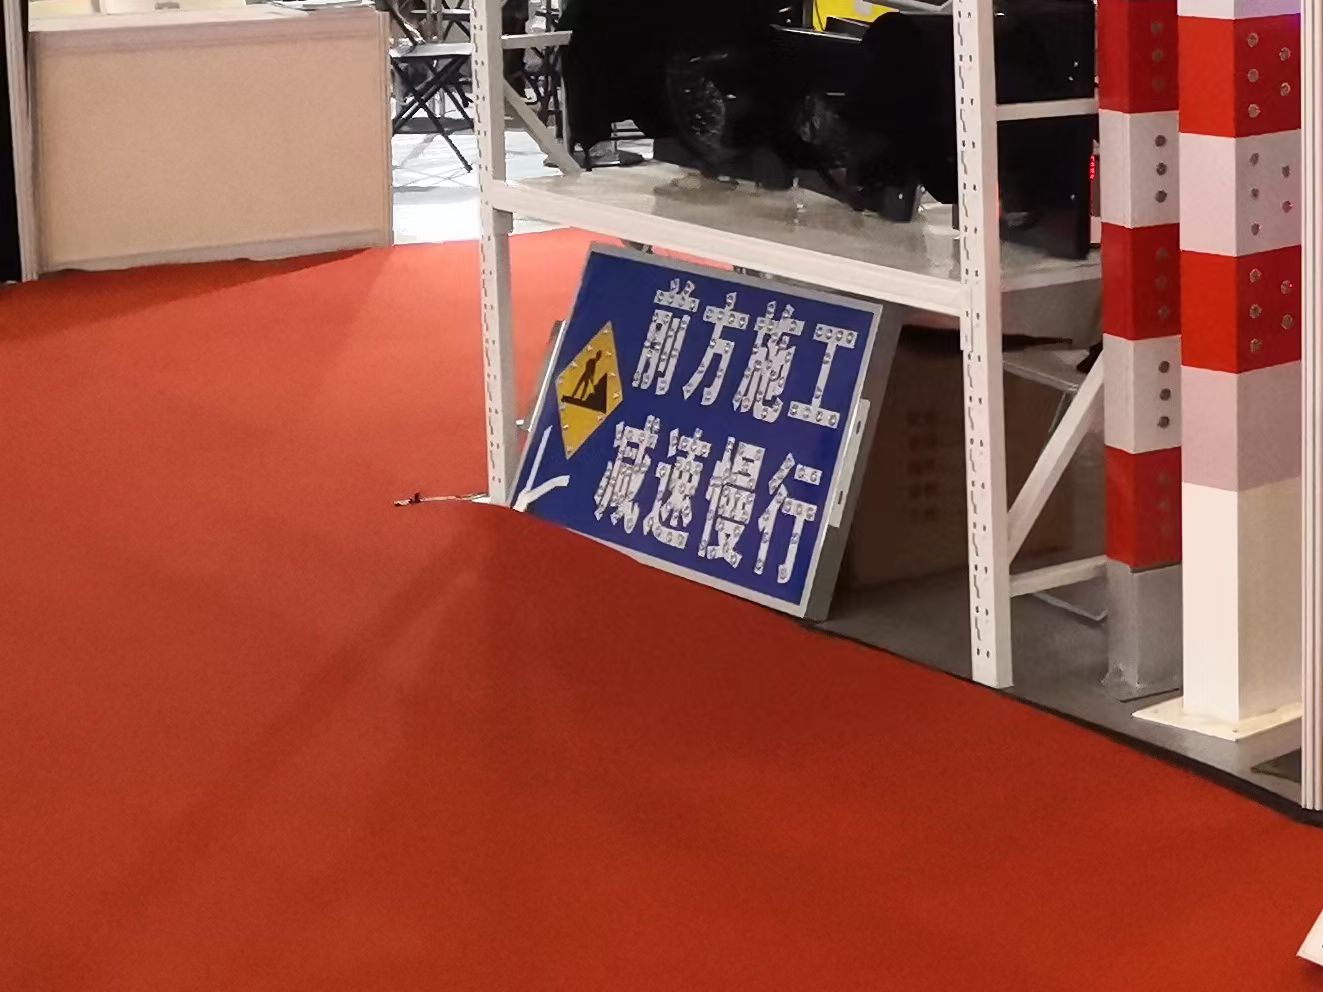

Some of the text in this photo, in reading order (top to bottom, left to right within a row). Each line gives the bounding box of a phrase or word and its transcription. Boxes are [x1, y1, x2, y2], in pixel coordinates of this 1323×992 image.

[632, 278, 858, 428] 前方施工
[594, 414, 823, 585] 减速慢行
